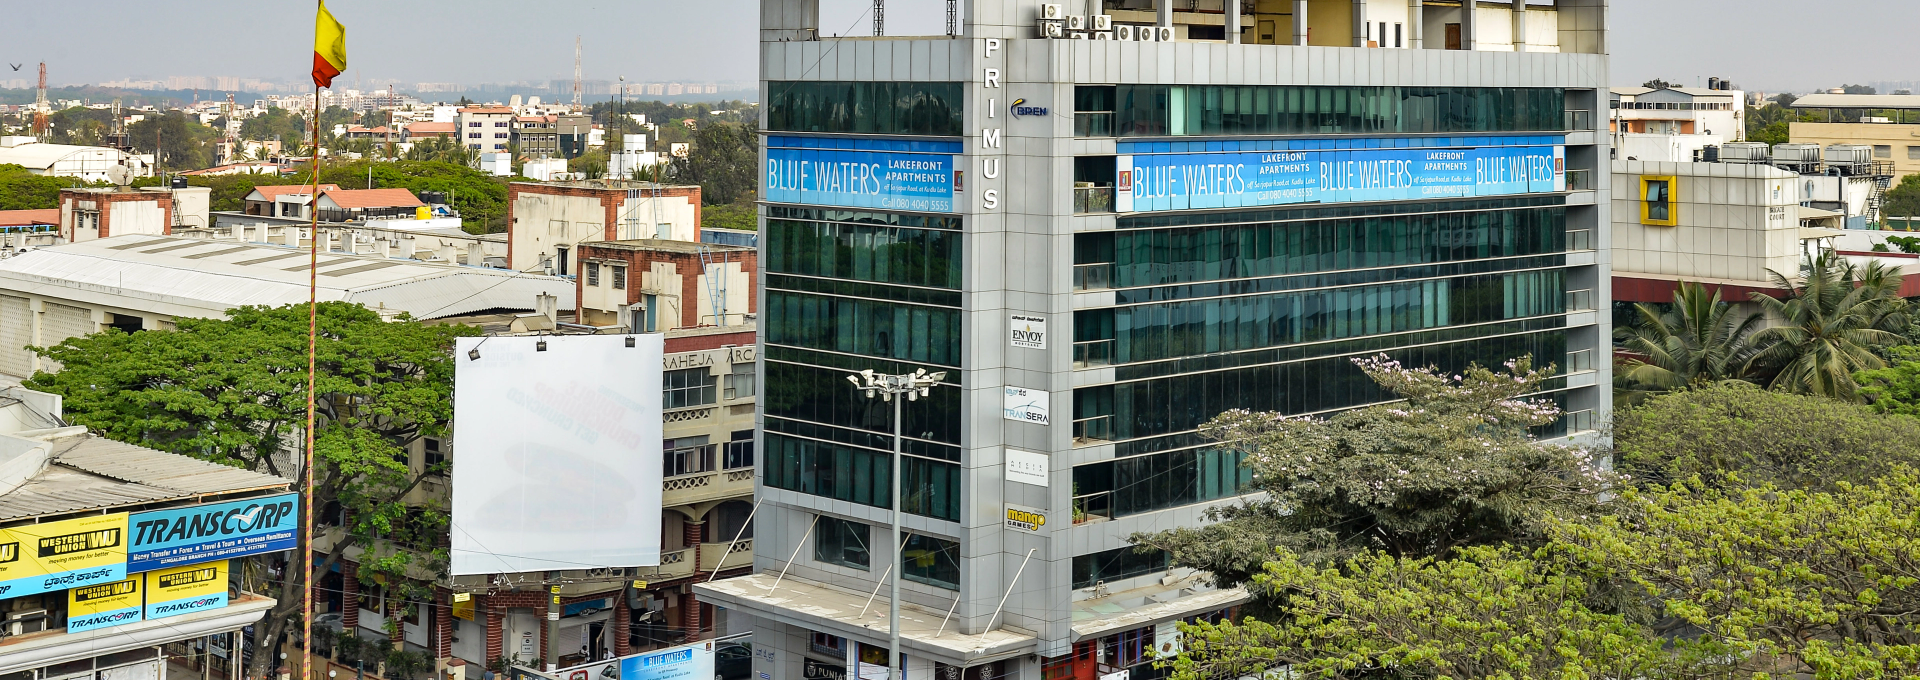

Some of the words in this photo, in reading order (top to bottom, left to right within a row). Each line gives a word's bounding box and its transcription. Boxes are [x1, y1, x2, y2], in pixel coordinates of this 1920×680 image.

[1017, 107, 1047, 116] BREN
[982, 38, 1000, 209] PRIMUS
[1262, 153, 1306, 163] LAKEFRONT
[1427, 152, 1464, 160] LAKEFRONT
[888, 160, 942, 170] LAKEFRONT
[1260, 164, 1309, 174] APARTMENTS
[1477, 157, 1505, 185] BLUE
[1509, 155, 1552, 183] WATERS
[768, 159, 808, 191] BLUE
[815, 162, 880, 195] WATERS
[886, 172, 946, 183] APARTMENTS
[1135, 165, 1176, 198] BLUE
[1183, 164, 1244, 196] WATERS
[1320, 161, 1353, 191] BLUE
[1359, 160, 1412, 189] WATERS
[1258, 191, 1269, 200] Call
[1270, 190, 1281, 199] 080
[1283, 189, 1297, 198] 4040
[1298, 188, 1312, 197] 5555
[1422, 186, 1432, 194] Call
[1433, 186, 1442, 194] 080
[1457, 185, 1469, 193] 5555
[882, 198, 895, 207] Call
[897, 199, 909, 208] 080
[912, 200, 928, 209] 4040
[932, 201, 948, 210] 5555
[1012, 330, 1043, 342] ENVOY
[663, 354, 714, 368] RAHEJA
[1004, 409, 1048, 422] TRANSERA
[134, 502, 293, 546] TRANSCORP
[1007, 508, 1045, 531] mango
[1008, 521, 1030, 529] GAMES
[41, 533, 86, 547] WESTERN
[90, 530, 116, 548] WU
[151, 550, 171, 558] Transfer
[266, 532, 291, 540] Remittance
[55, 542, 85, 553] UNION
[161, 556, 187, 564] BANGALORE
[161, 572, 192, 581] WESTERN
[171, 577, 192, 585] UNION
[196, 569, 213, 581] WU
[78, 585, 110, 595] WESTERN
[88, 590, 110, 598] UNION
[114, 582, 133, 594] WU
[156, 597, 219, 614] TRANSCORP
[72, 611, 138, 628] TRANSCORP
[649, 656, 663, 667] BLUE
[665, 651, 686, 664] WATERS
